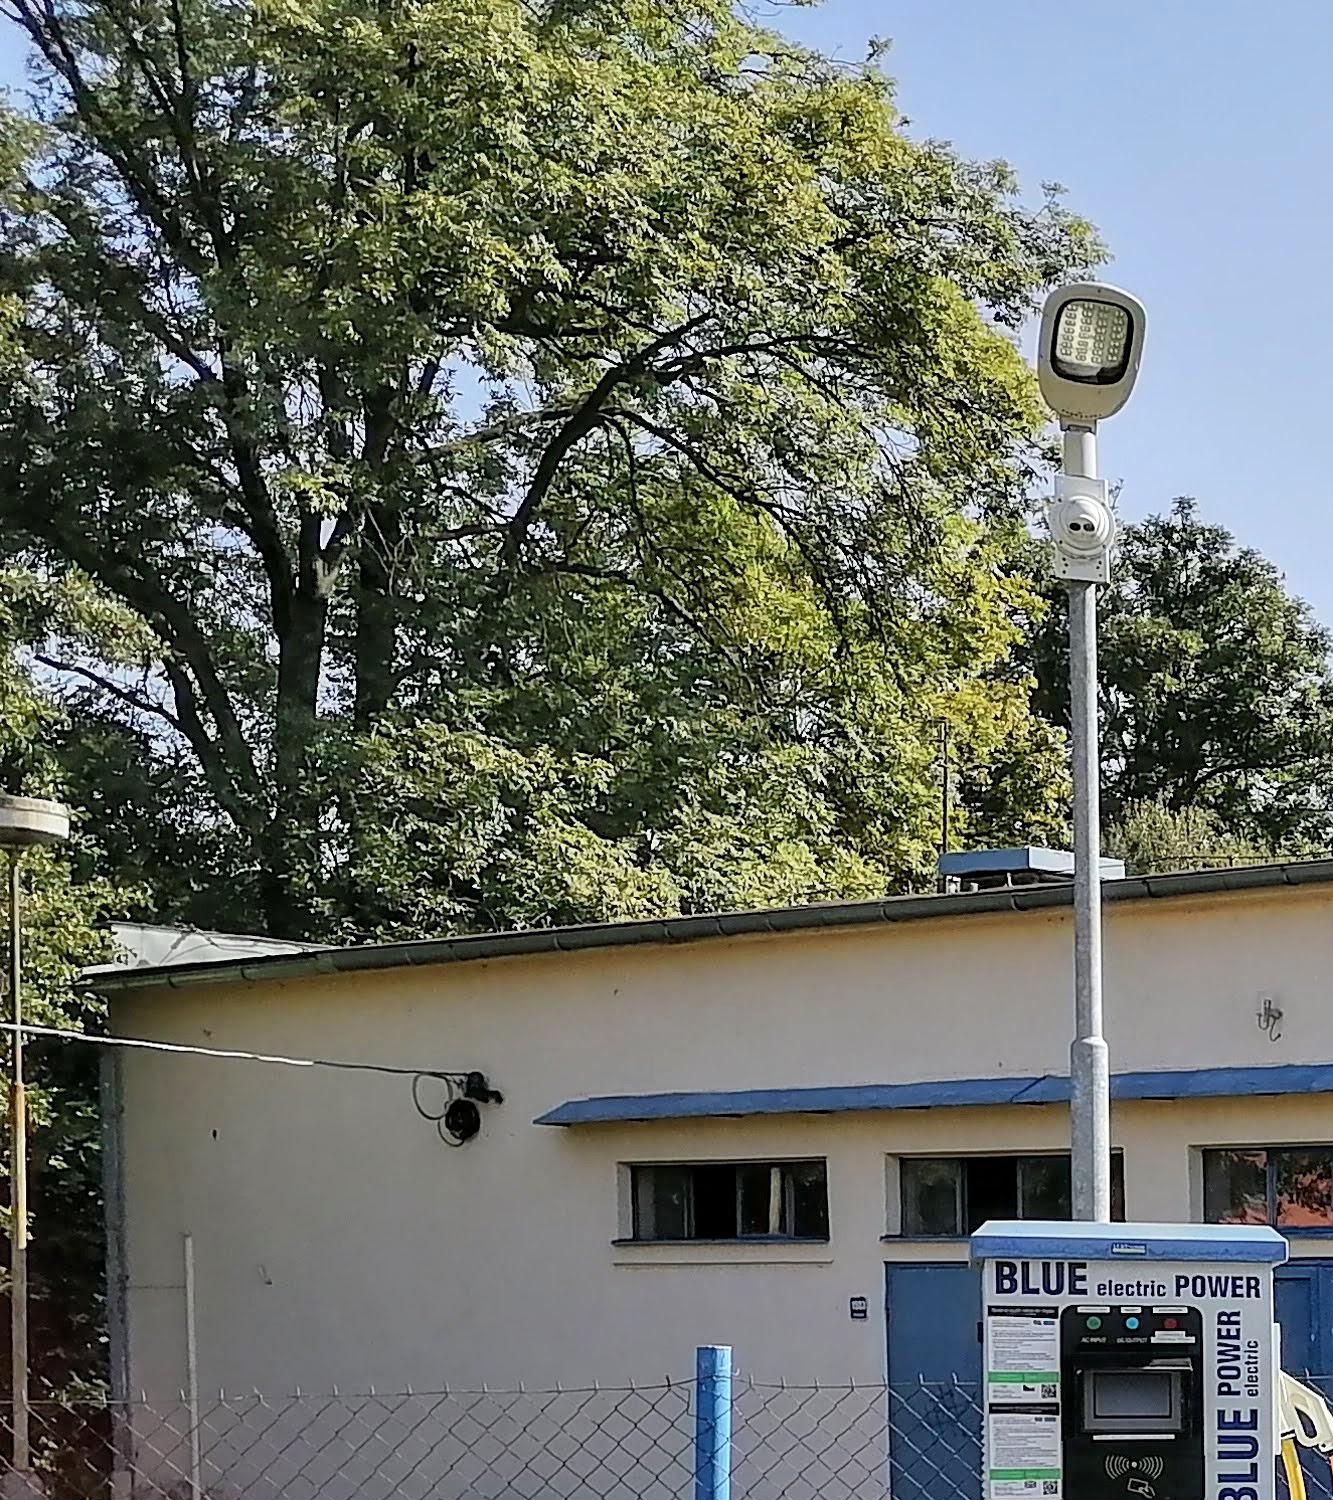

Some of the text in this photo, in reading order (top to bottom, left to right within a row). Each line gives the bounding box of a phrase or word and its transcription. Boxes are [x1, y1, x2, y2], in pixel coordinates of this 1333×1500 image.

[994, 1260, 1262, 1299] BLUE electric POWER
[1216, 1310, 1242, 1397] POWER
[1243, 1339, 1260, 1398] electric
